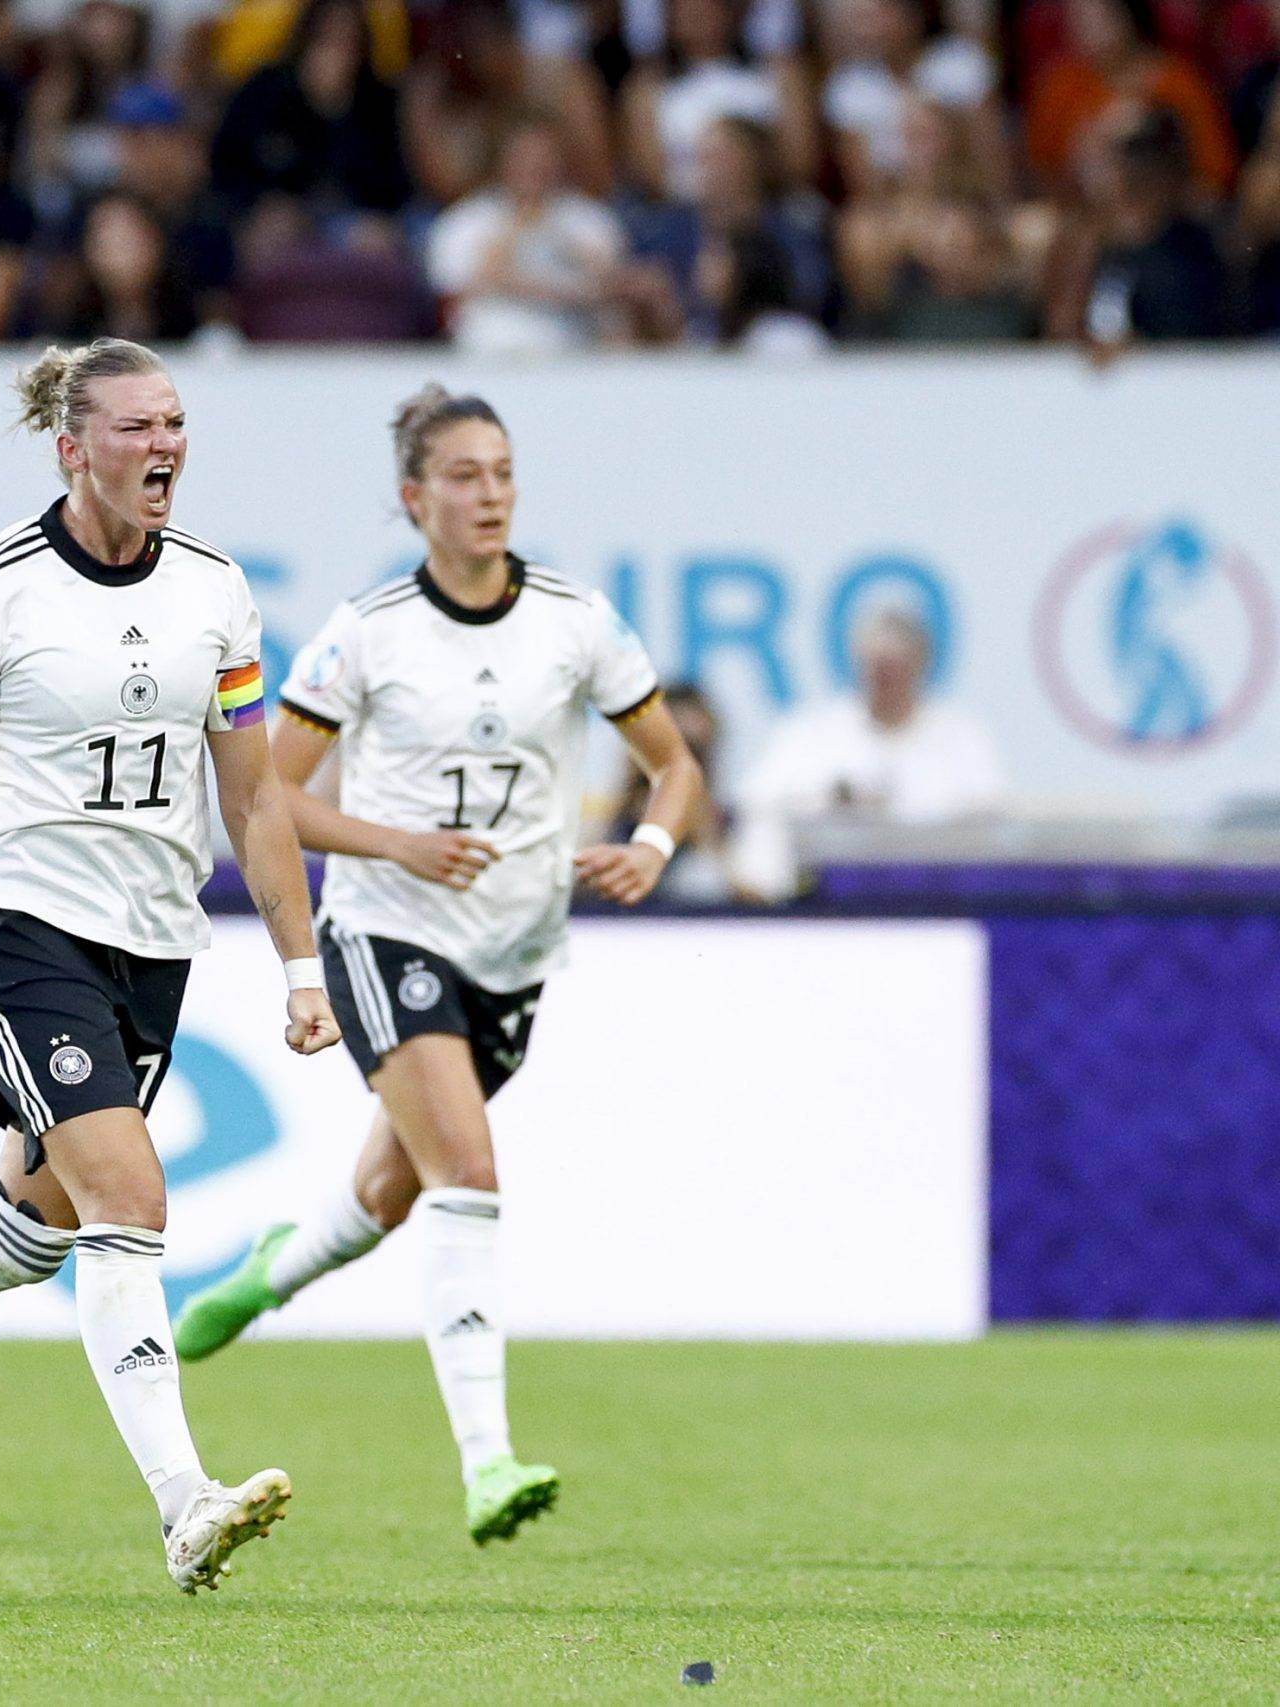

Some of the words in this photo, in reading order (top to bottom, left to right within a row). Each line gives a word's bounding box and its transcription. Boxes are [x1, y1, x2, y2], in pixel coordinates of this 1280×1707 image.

[83, 731, 171, 811] 11
[438, 763, 522, 829] 17
[113, 1355, 174, 1375] adidas
